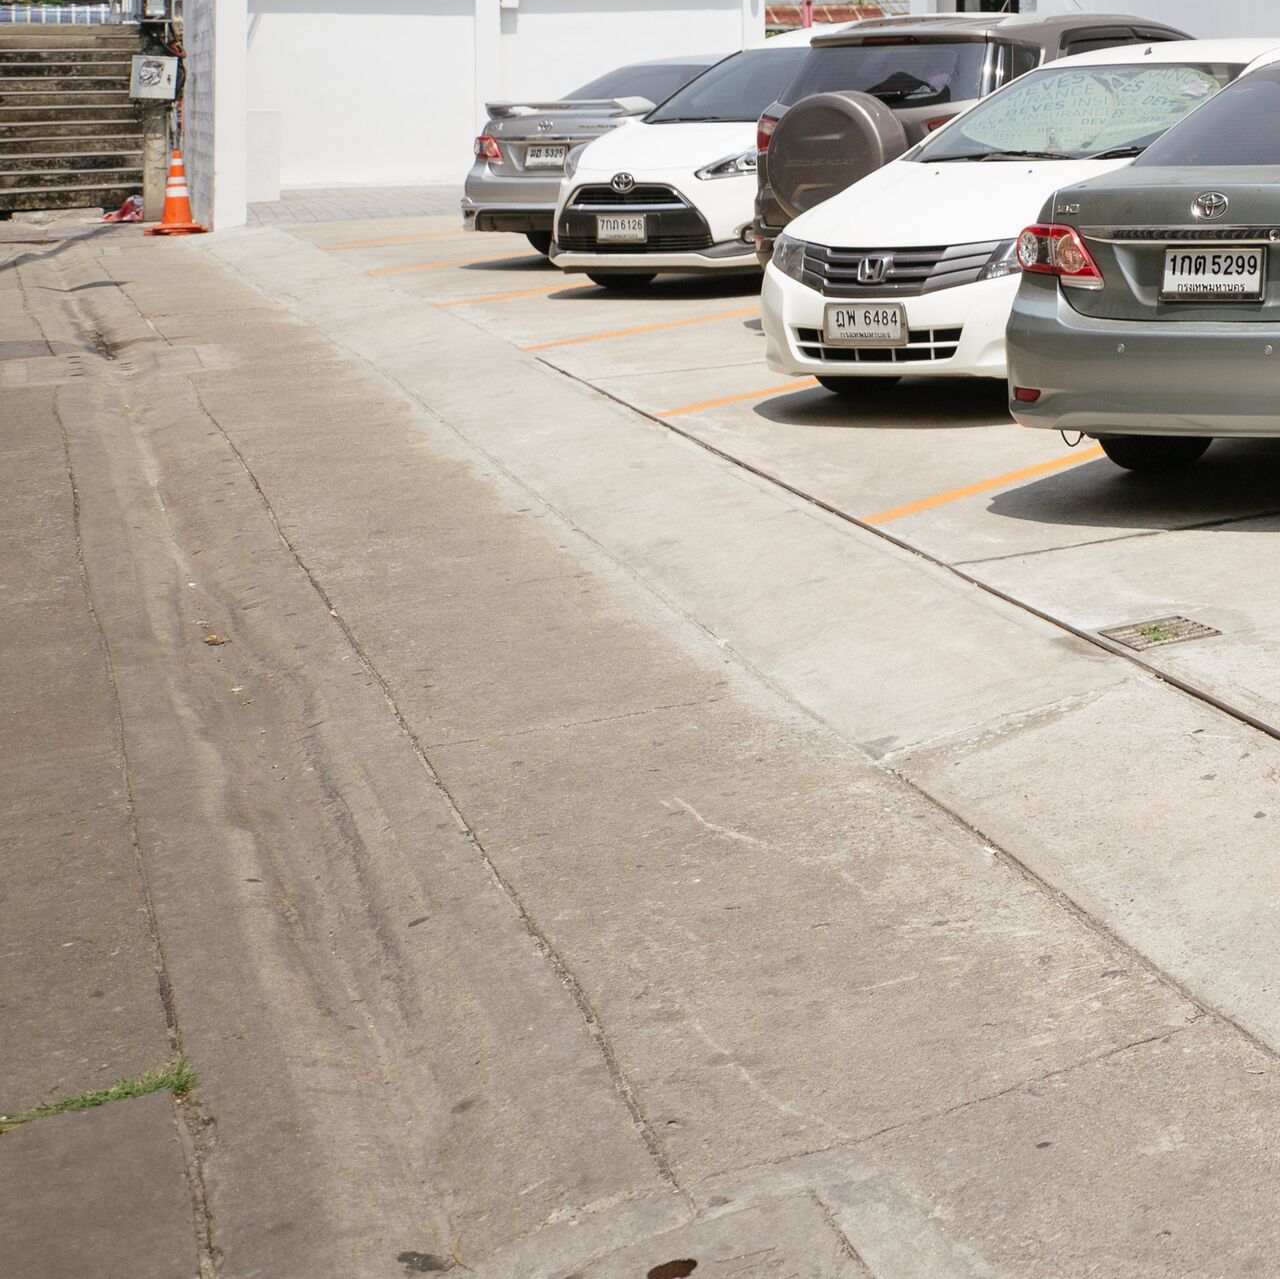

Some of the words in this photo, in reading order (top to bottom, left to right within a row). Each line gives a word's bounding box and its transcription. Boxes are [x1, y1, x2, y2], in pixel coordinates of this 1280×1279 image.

[620, 219, 643, 230] 6126
[1169, 254, 1207, 276] 1กต
[1211, 254, 1258, 276] 5299
[1176, 282, 1246, 292] กรงเทพมหานคร
[863, 310, 898, 326] 6484
